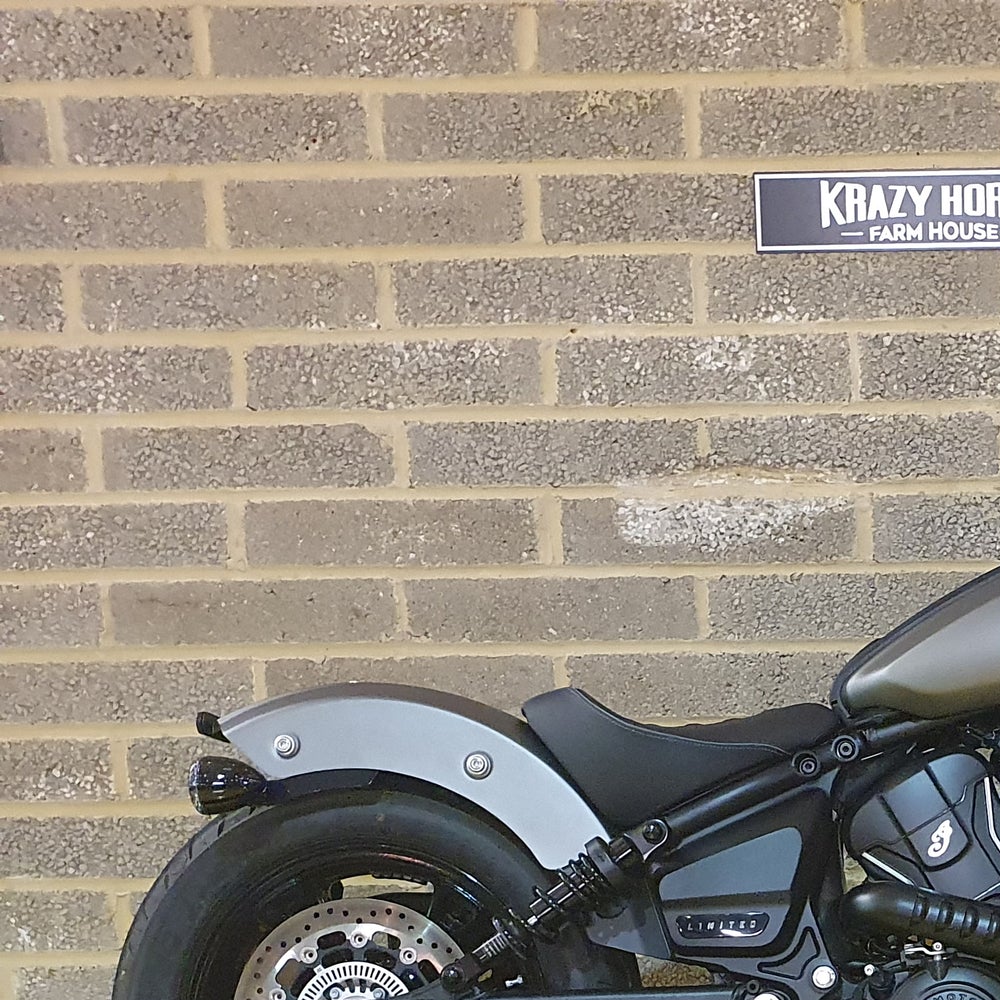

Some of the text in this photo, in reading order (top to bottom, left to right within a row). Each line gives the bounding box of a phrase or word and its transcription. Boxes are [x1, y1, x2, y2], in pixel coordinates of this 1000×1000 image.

[820, 180, 933, 229] KRAZY
[869, 221, 999, 242] FARM HOUSE
[687, 920, 757, 931] LIMITED
